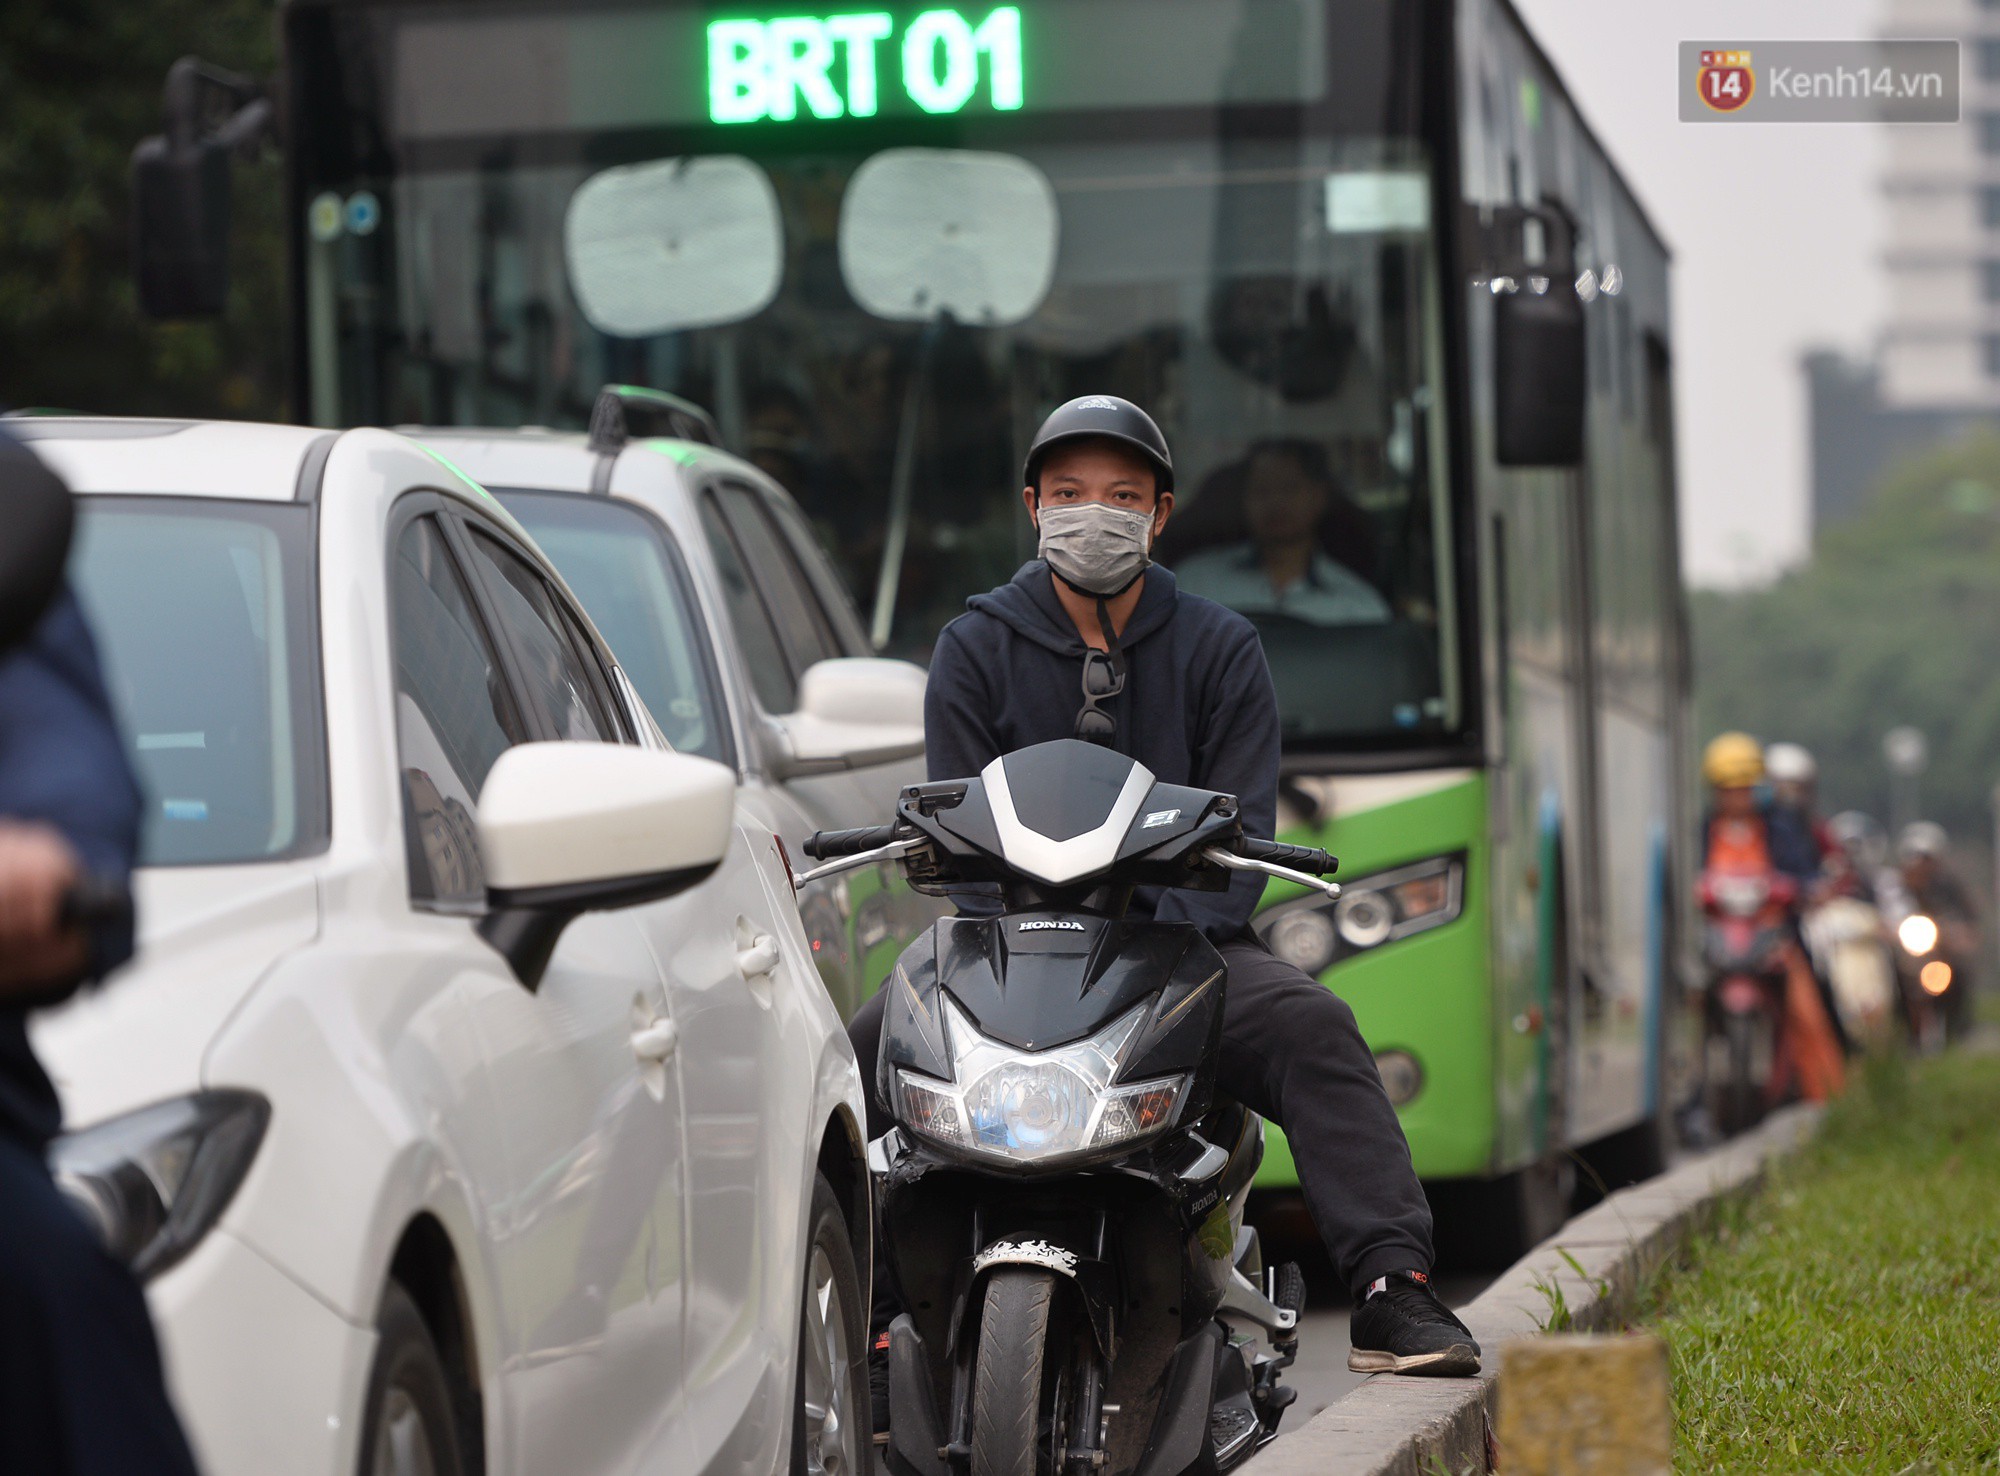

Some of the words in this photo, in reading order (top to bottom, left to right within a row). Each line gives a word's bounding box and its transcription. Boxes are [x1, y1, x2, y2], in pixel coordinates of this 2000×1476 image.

[706, 12, 893, 125] BRT
[901, 6, 1024, 114] 01
[1077, 401, 1118, 411] adidas
[1018, 921, 1085, 931] HONDA
[1191, 1189, 1218, 1215] HONDA
[1411, 1270, 1428, 1283] NEO
